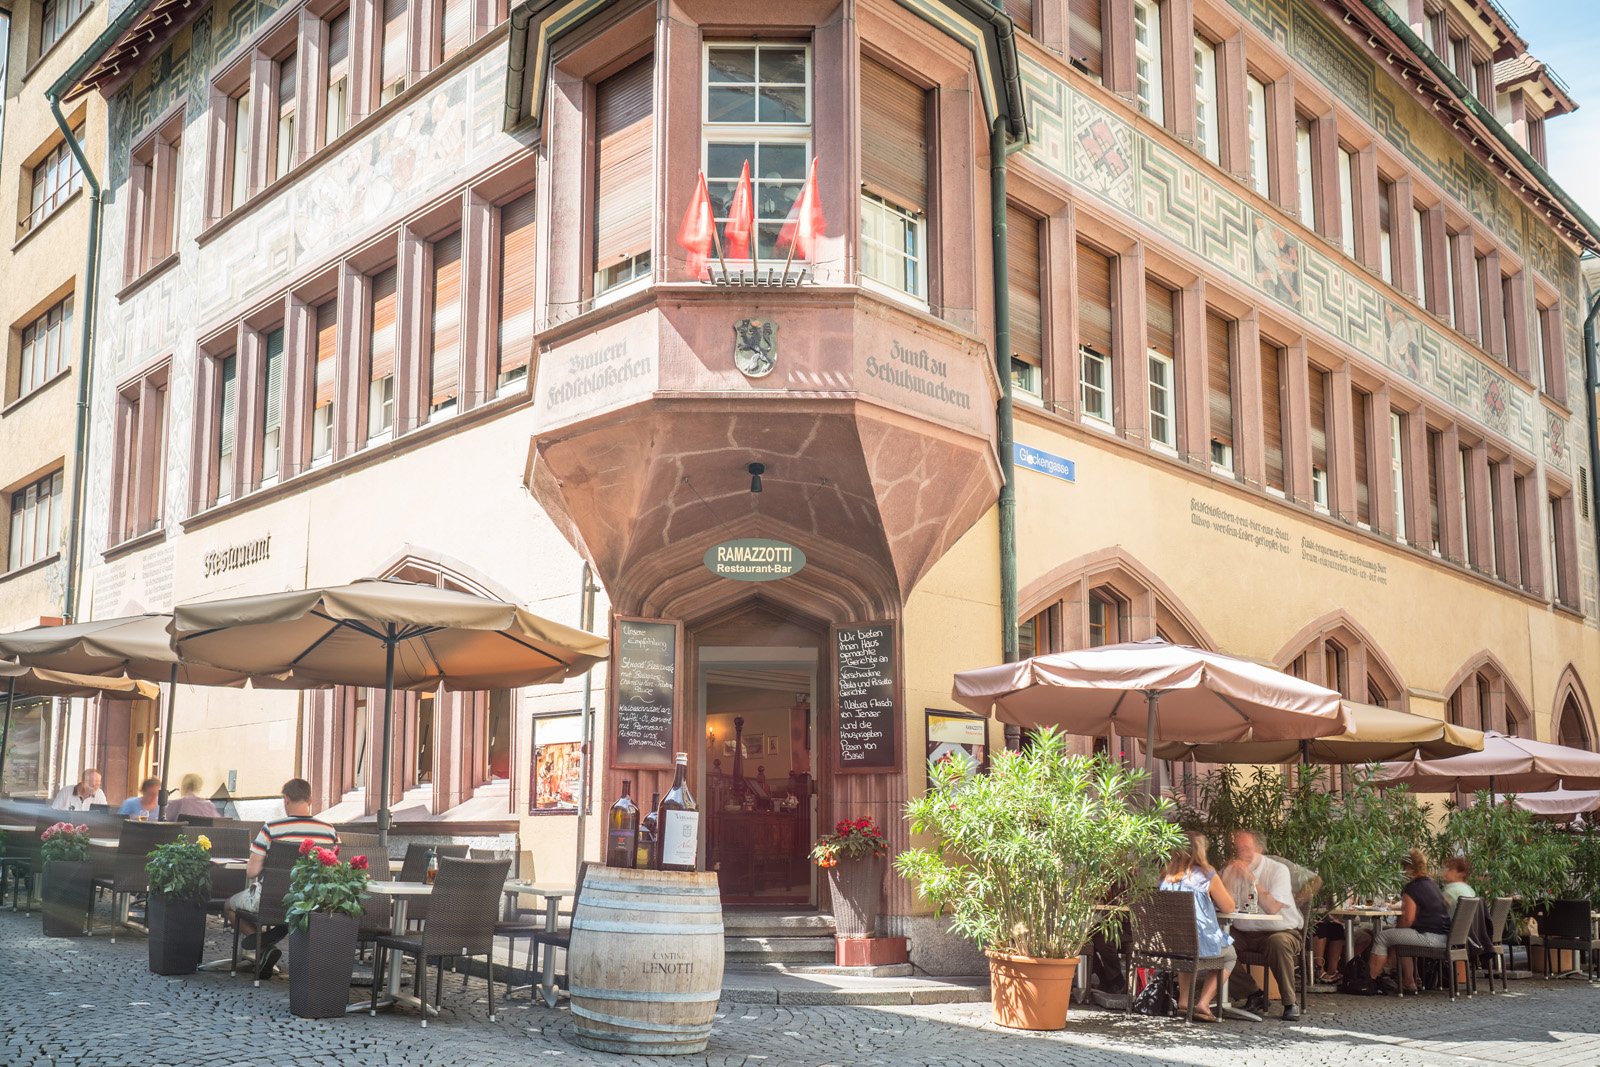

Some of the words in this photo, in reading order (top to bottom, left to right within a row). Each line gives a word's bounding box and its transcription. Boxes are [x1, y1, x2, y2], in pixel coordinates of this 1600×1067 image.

[569, 337, 627, 374] Brauerei
[890, 340, 929, 372] Zunft
[931, 358, 947, 378] zu
[866, 356, 970, 410] Schuhmachern
[1019, 448, 1069, 475] Glckengasse
[204, 533, 271, 578] Restaurant
[718, 547, 792, 562] RAMAZZOTTI
[717, 563, 792, 573] Restaurant-Bar
[839, 632, 855, 642] Wir
[857, 629, 883, 640] bieten
[861, 639, 879, 649] Haus
[839, 649, 876, 660] gemachte
[879, 655, 889, 663] an
[839, 679, 857, 689] Pasta
[857, 679, 870, 688] und
[859, 720, 873, 729] die
[842, 750, 865, 760] Basel
[642, 962, 693, 974] LENOTTI
